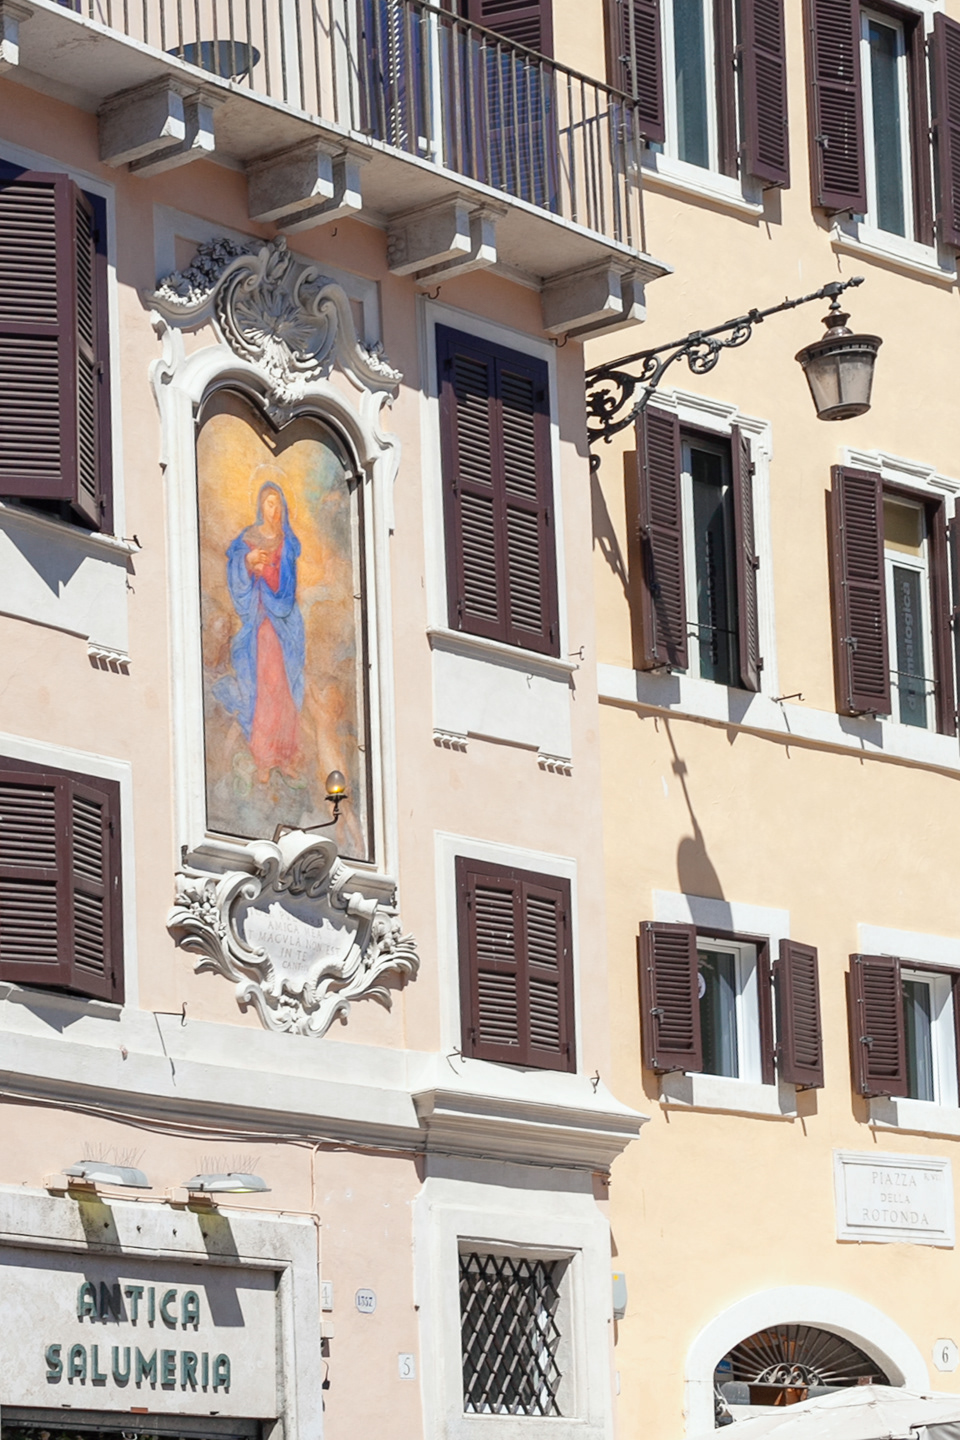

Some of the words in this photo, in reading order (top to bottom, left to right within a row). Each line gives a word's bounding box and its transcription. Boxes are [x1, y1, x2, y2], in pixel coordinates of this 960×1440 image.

[903, 582, 916, 710] drmalogica
[268, 921, 300, 934] AMICA
[280, 947, 293, 959] IN
[872, 1171, 917, 1187] PIAZZA
[880, 1193, 911, 1204] DELLA
[862, 1208, 929, 1225] ROTONDA
[77, 1281, 200, 1327] ANTICA
[941, 1346, 949, 1364] 6
[45, 1343, 231, 1389] SALUMERIA
[403, 1357, 411, 1376] 5
